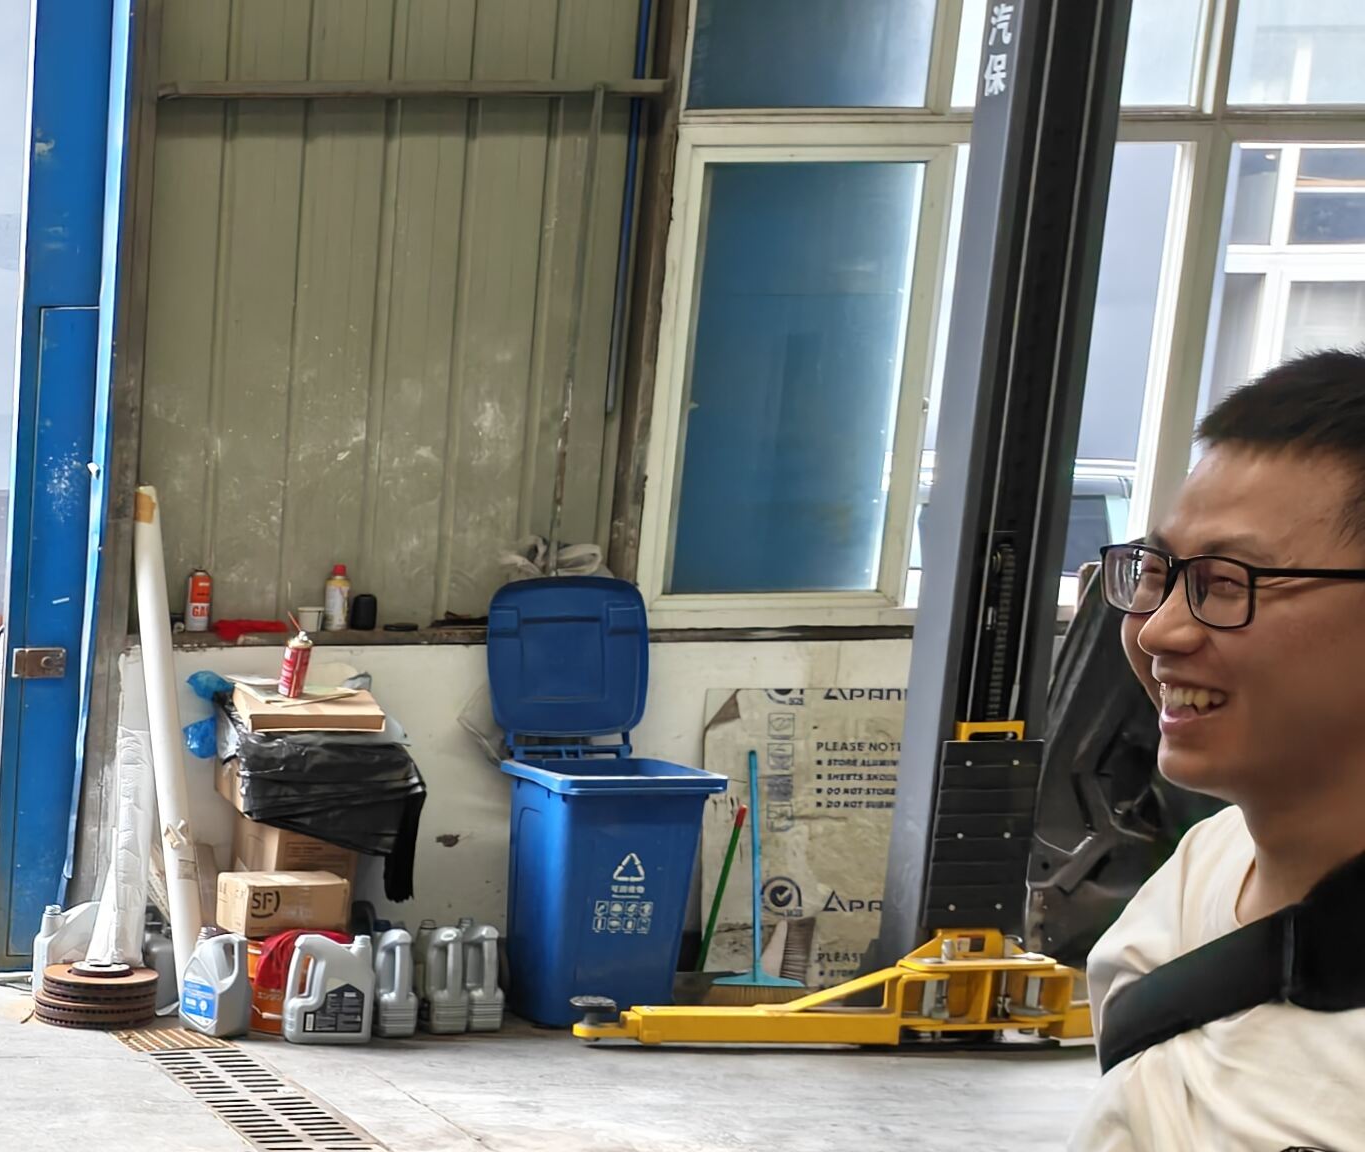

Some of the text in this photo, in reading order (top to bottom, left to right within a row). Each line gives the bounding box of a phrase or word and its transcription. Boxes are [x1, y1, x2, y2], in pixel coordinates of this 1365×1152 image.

[984, 3, 1014, 97] 汽保
[816, 742, 865, 752] PLEASE
[252, 892, 273, 911] SF
